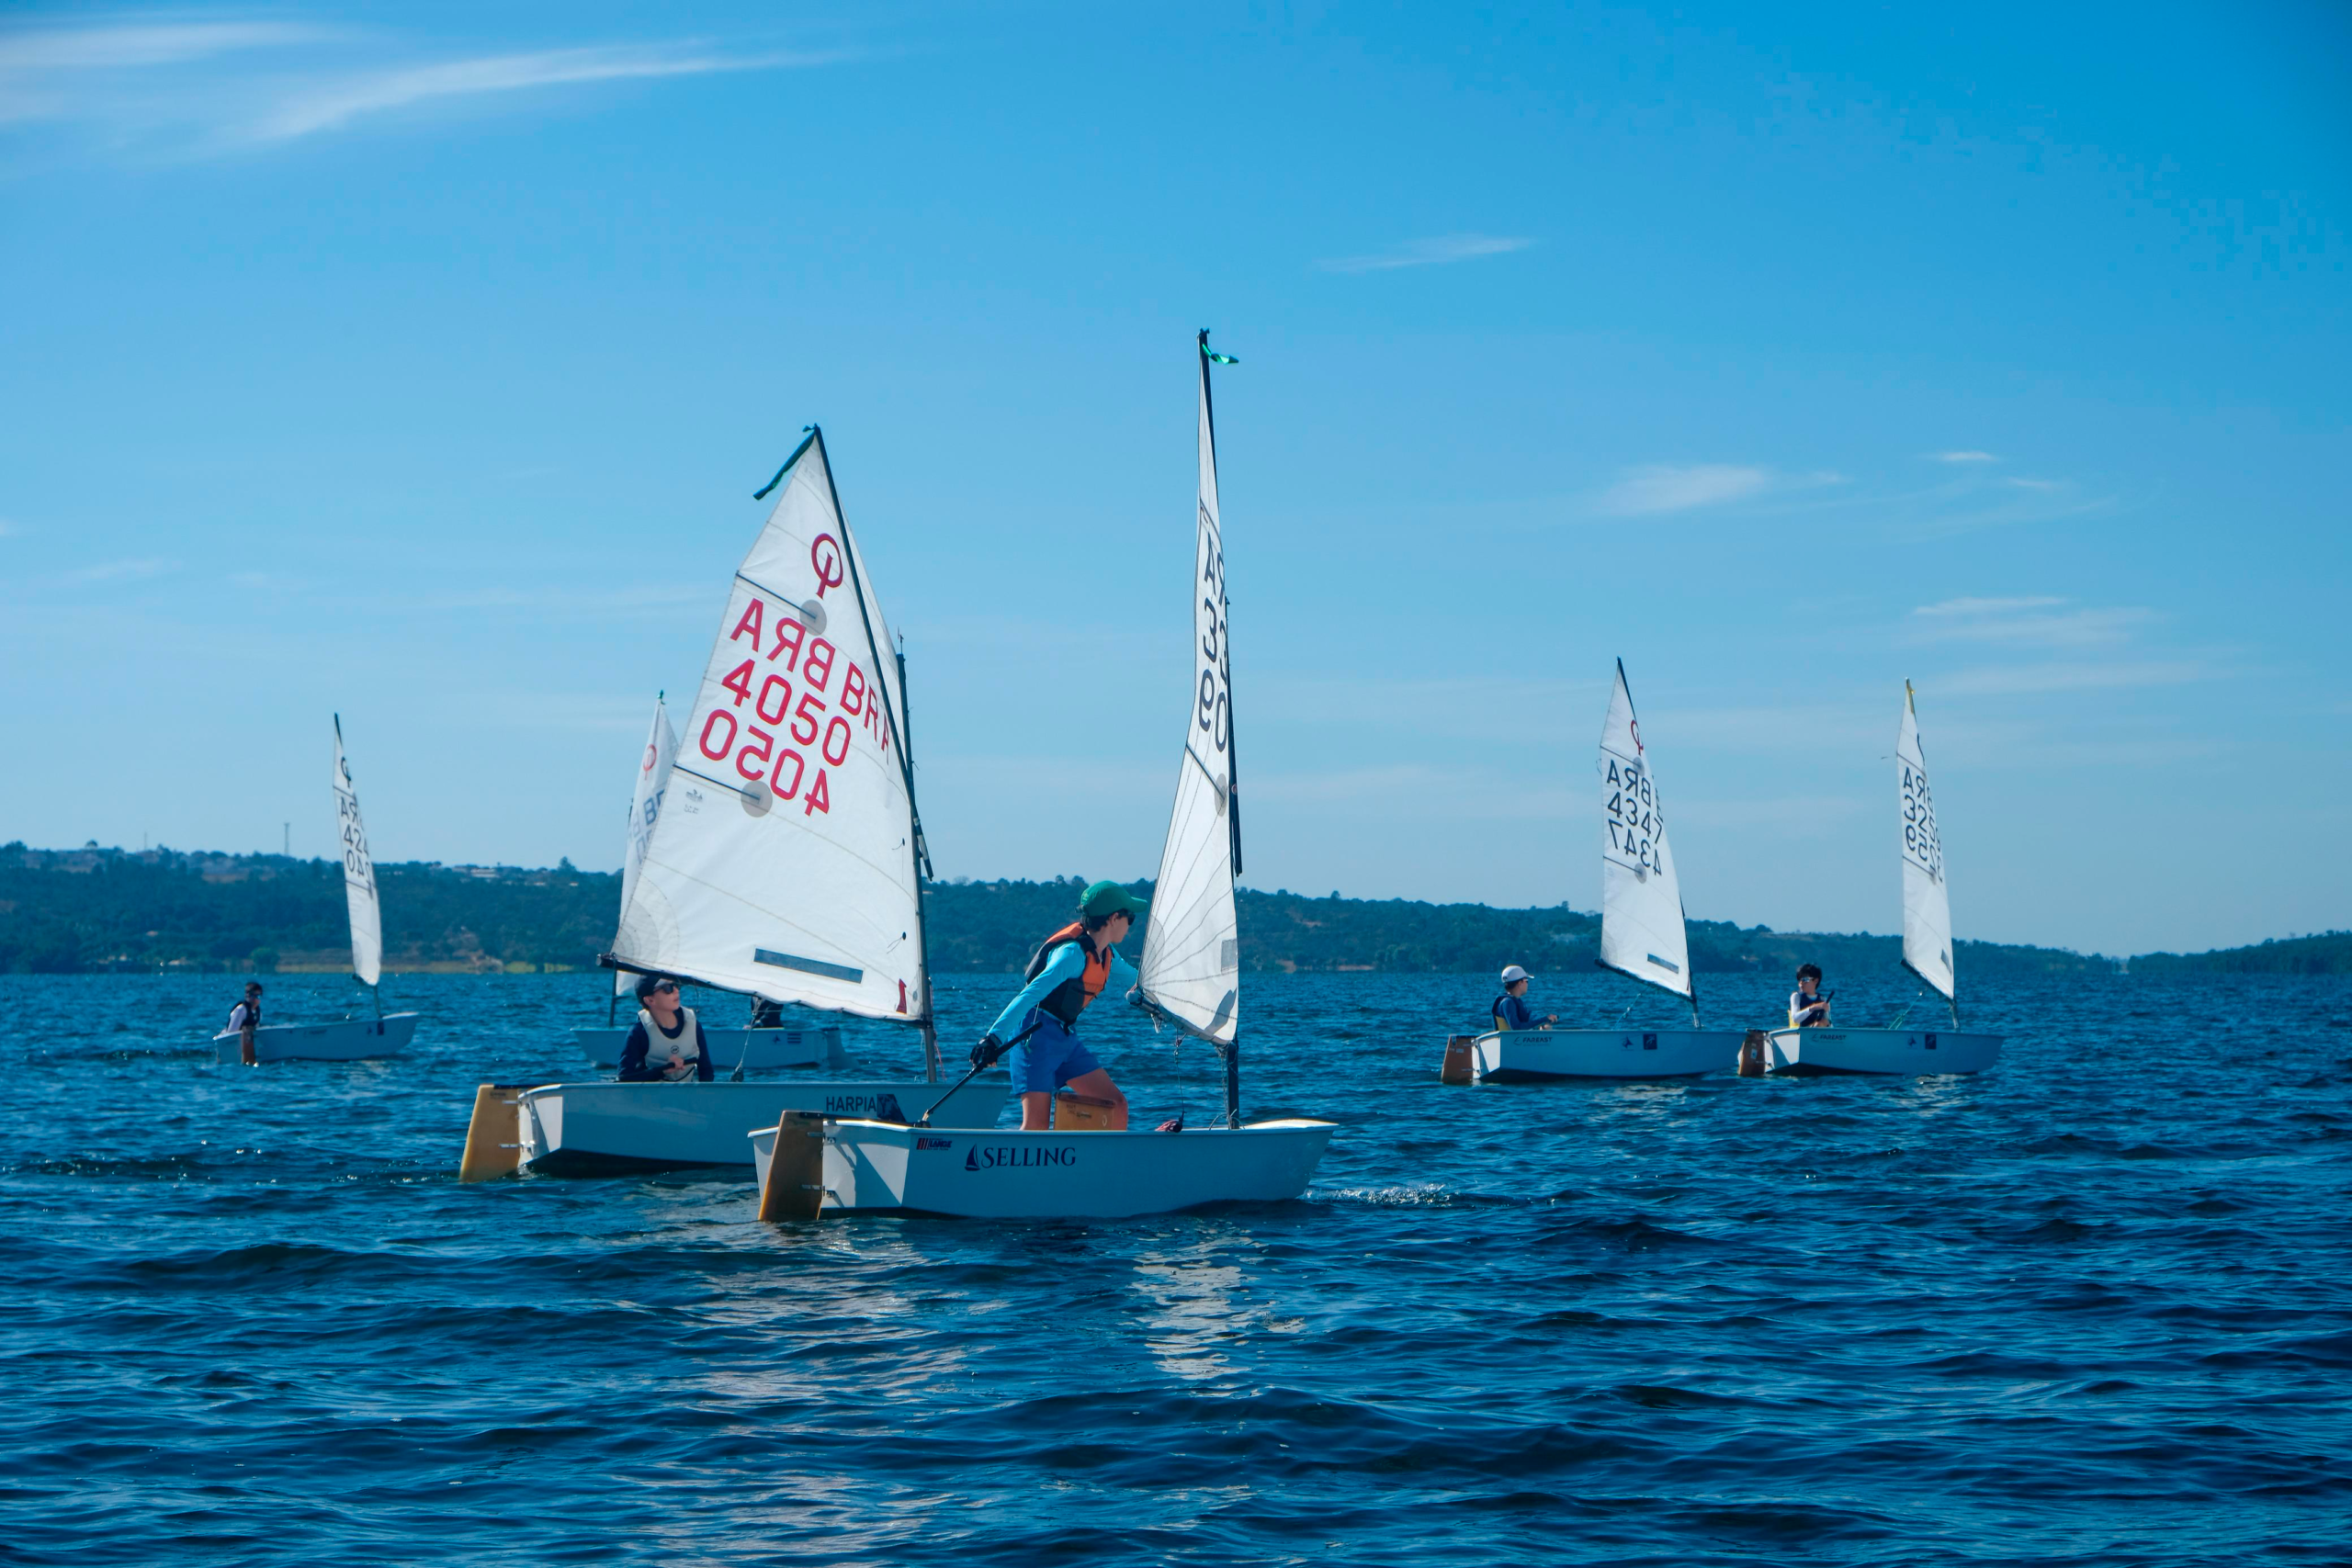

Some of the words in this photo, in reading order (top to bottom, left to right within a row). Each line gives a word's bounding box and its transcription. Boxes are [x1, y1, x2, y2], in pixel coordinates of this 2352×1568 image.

[720, 658, 852, 767] 4050
[1607, 791, 1663, 845] 4347
[825, 1095, 877, 1112] HARPIA
[980, 1146, 1076, 1168] SELLING
